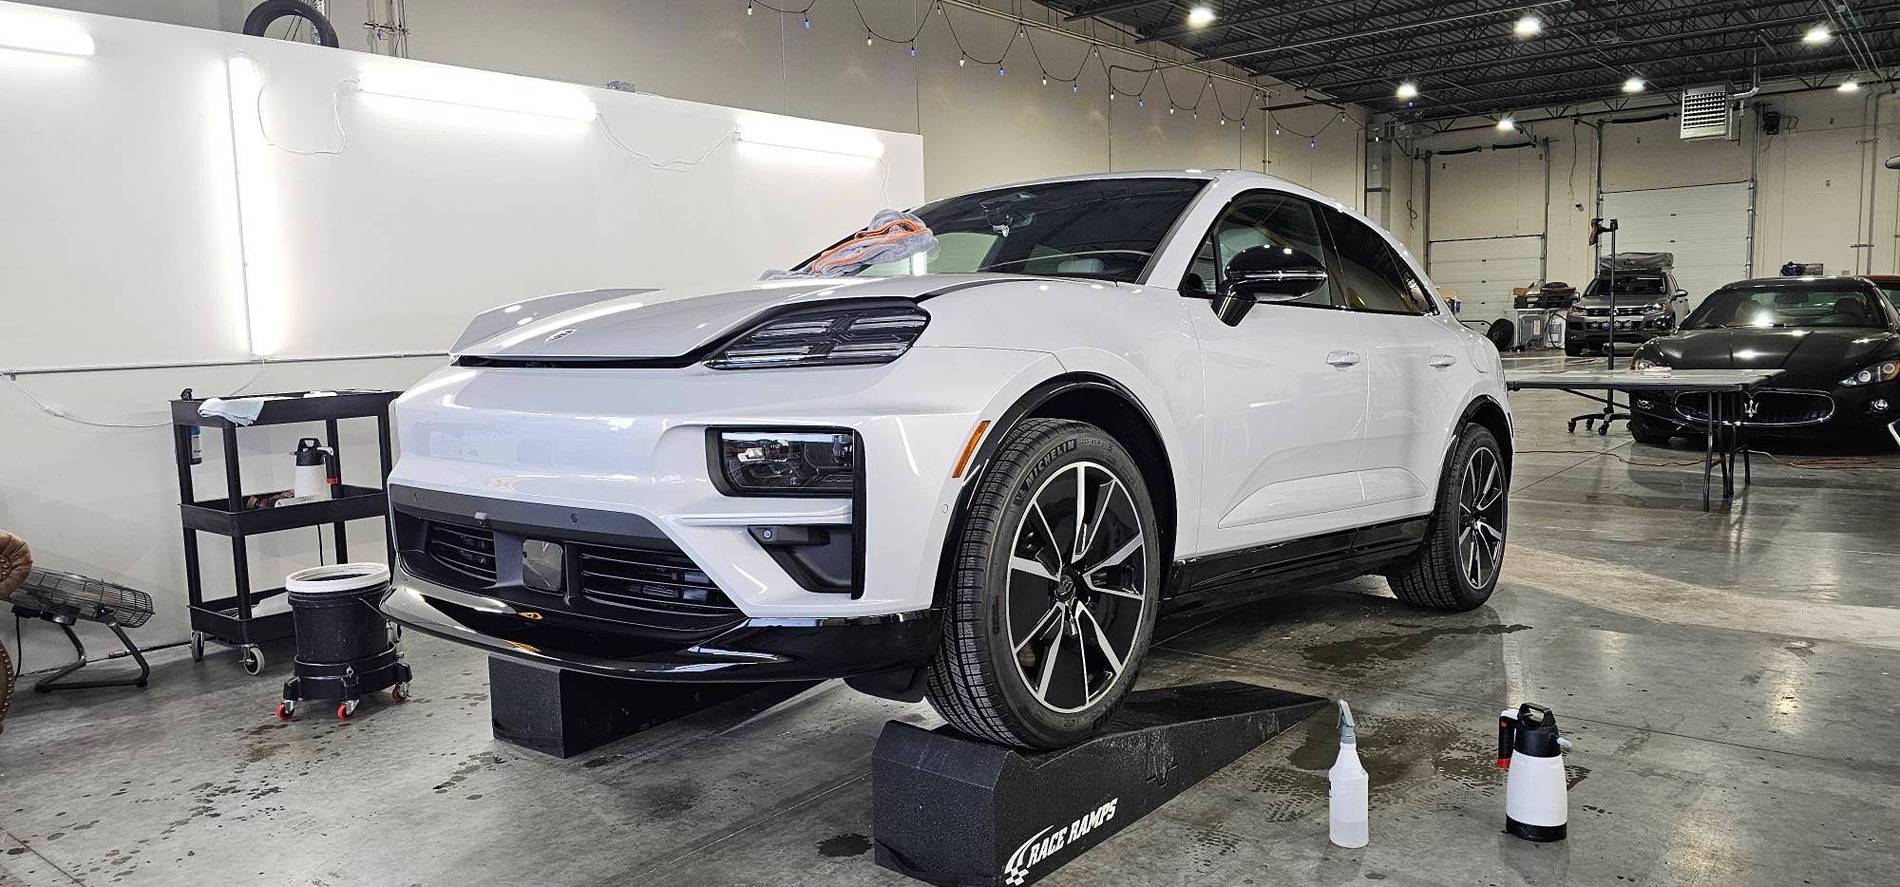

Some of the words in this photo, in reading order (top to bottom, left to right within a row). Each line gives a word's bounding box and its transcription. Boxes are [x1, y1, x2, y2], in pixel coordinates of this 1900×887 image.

[1025, 440, 1076, 489] MICHELIN
[1026, 826, 1068, 869] RACE
[1067, 797, 1118, 845] RAMPS
